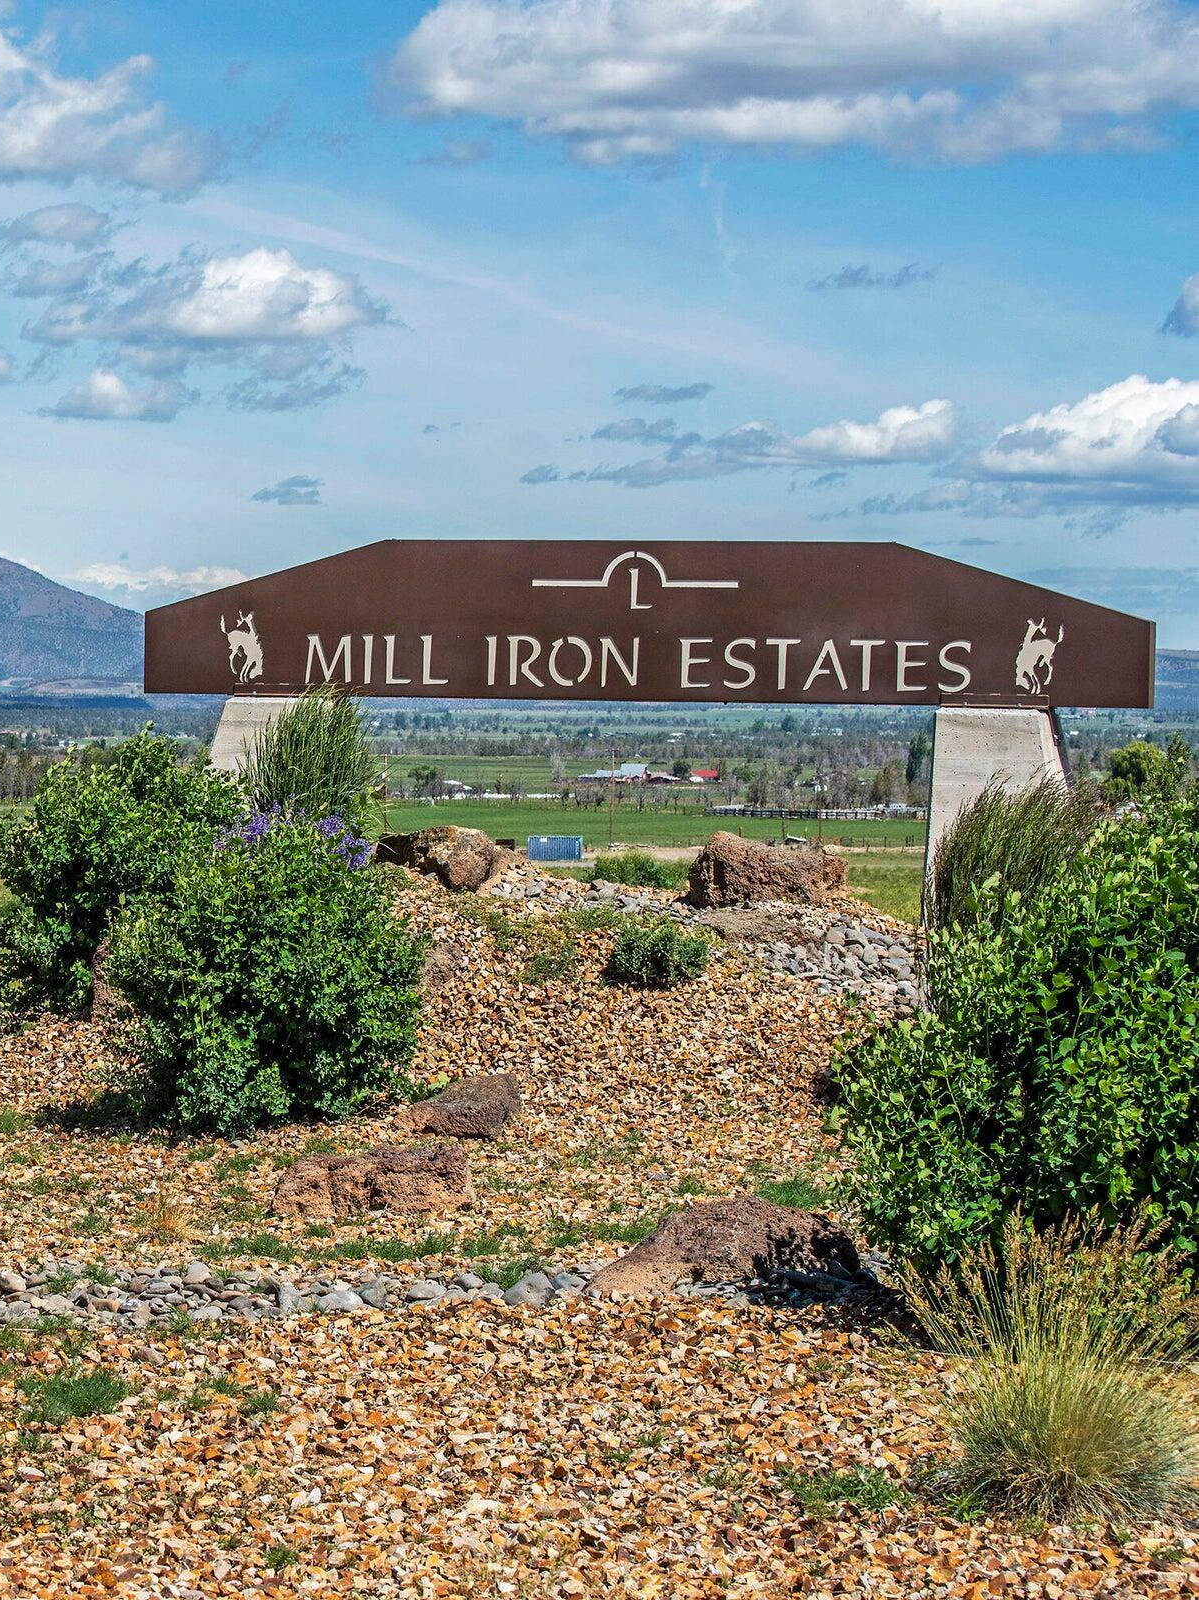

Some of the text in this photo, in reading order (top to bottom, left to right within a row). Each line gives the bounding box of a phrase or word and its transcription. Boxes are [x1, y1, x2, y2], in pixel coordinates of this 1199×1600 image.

[305, 634, 972, 693] MILL IRON ESTATES
